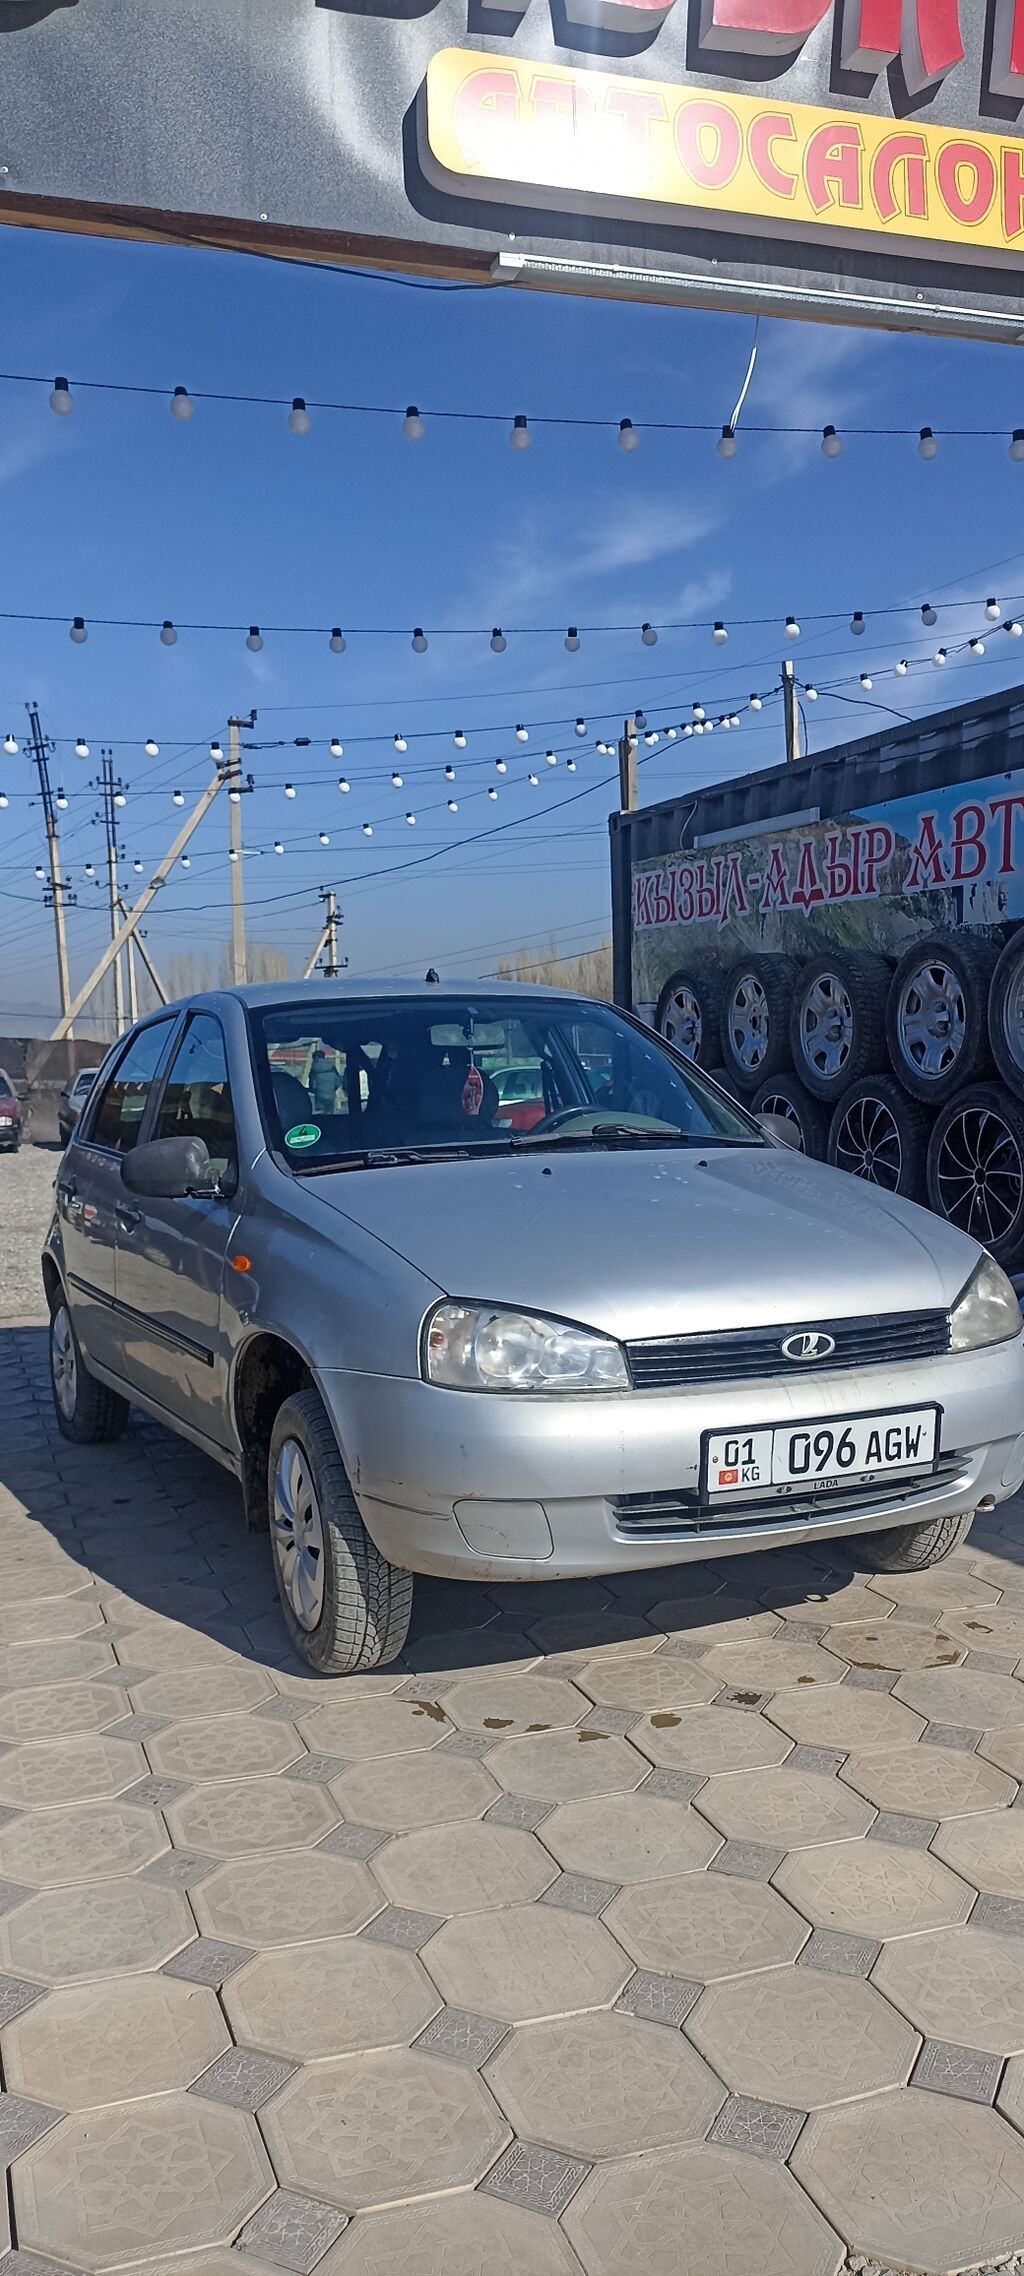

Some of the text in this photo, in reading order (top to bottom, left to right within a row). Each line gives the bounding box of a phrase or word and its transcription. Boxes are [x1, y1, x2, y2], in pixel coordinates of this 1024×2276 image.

[636, 827, 893, 926] КЫЗЫЛ-АДЫР
[725, 1424, 922, 1475] 01 096 AGW
[741, 1466, 760, 1482] KG
[813, 1479, 839, 1490] LADA
